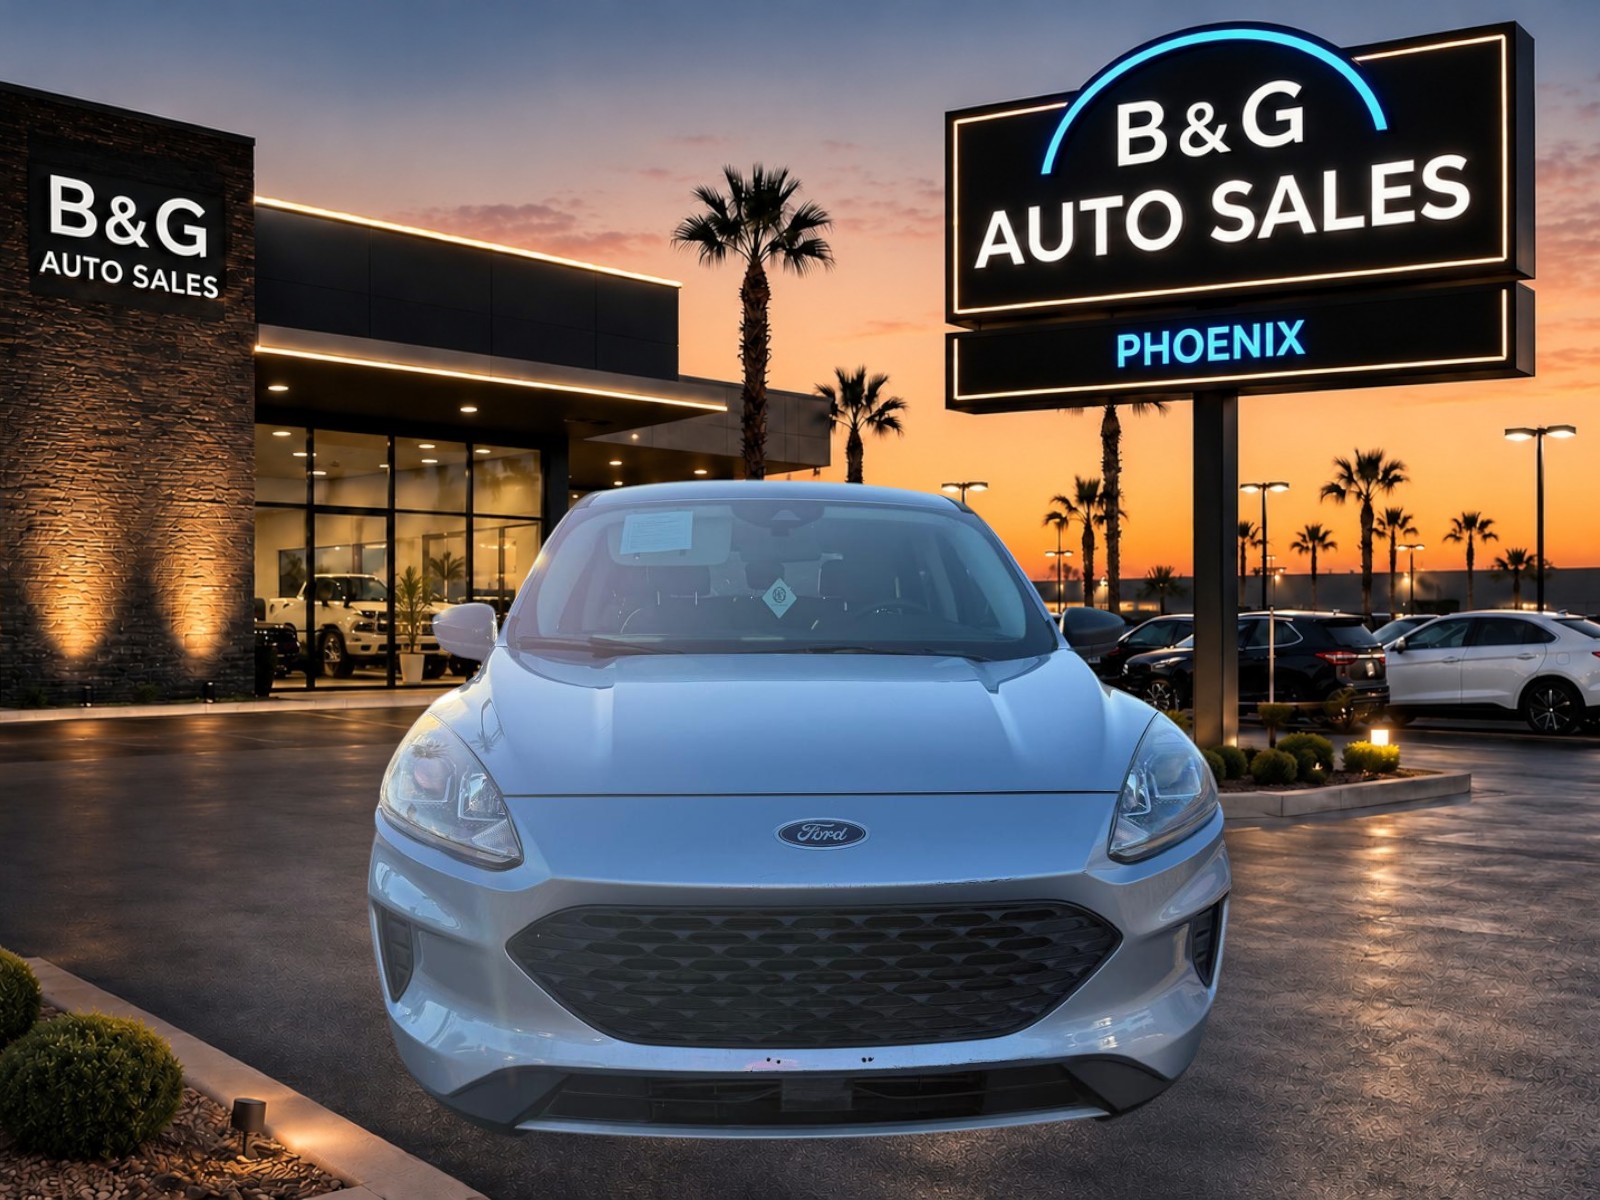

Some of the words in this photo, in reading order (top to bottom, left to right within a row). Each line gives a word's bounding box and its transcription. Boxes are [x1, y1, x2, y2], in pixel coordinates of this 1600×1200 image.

[974, 189, 1184, 269] AUTO
[1210, 154, 1472, 243] SALES
[39, 250, 124, 284] AUTO
[132, 264, 219, 299] SALES
[1117, 319, 1306, 368] PHOENIX
[797, 823, 848, 841] Ford
